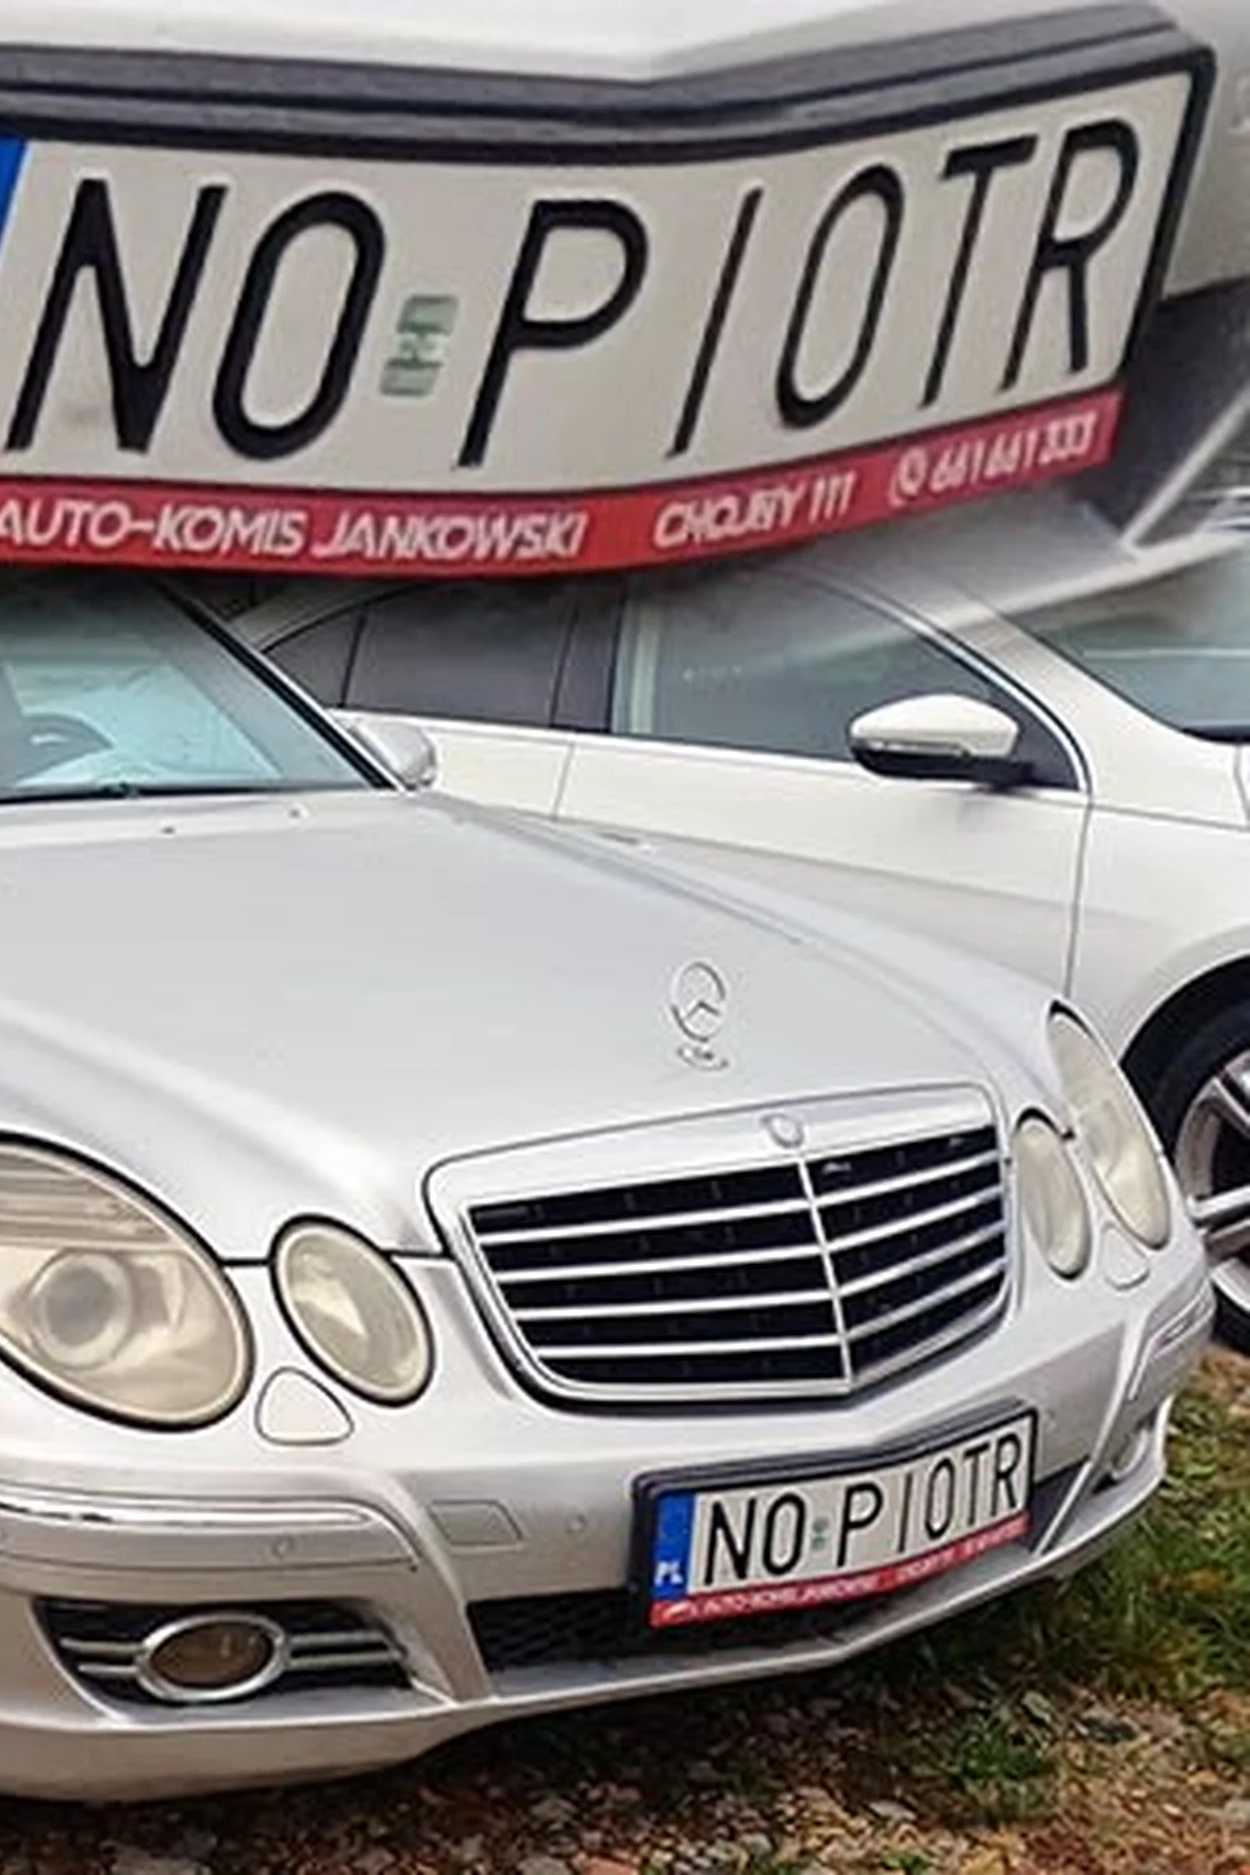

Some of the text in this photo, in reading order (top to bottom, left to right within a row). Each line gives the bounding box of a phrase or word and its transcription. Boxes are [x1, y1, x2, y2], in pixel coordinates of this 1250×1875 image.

[455, 117, 1141, 468] PIOTR
[311, 510, 589, 560] JANKOWSKI
[836, 1433, 1022, 1568] PIOTR
